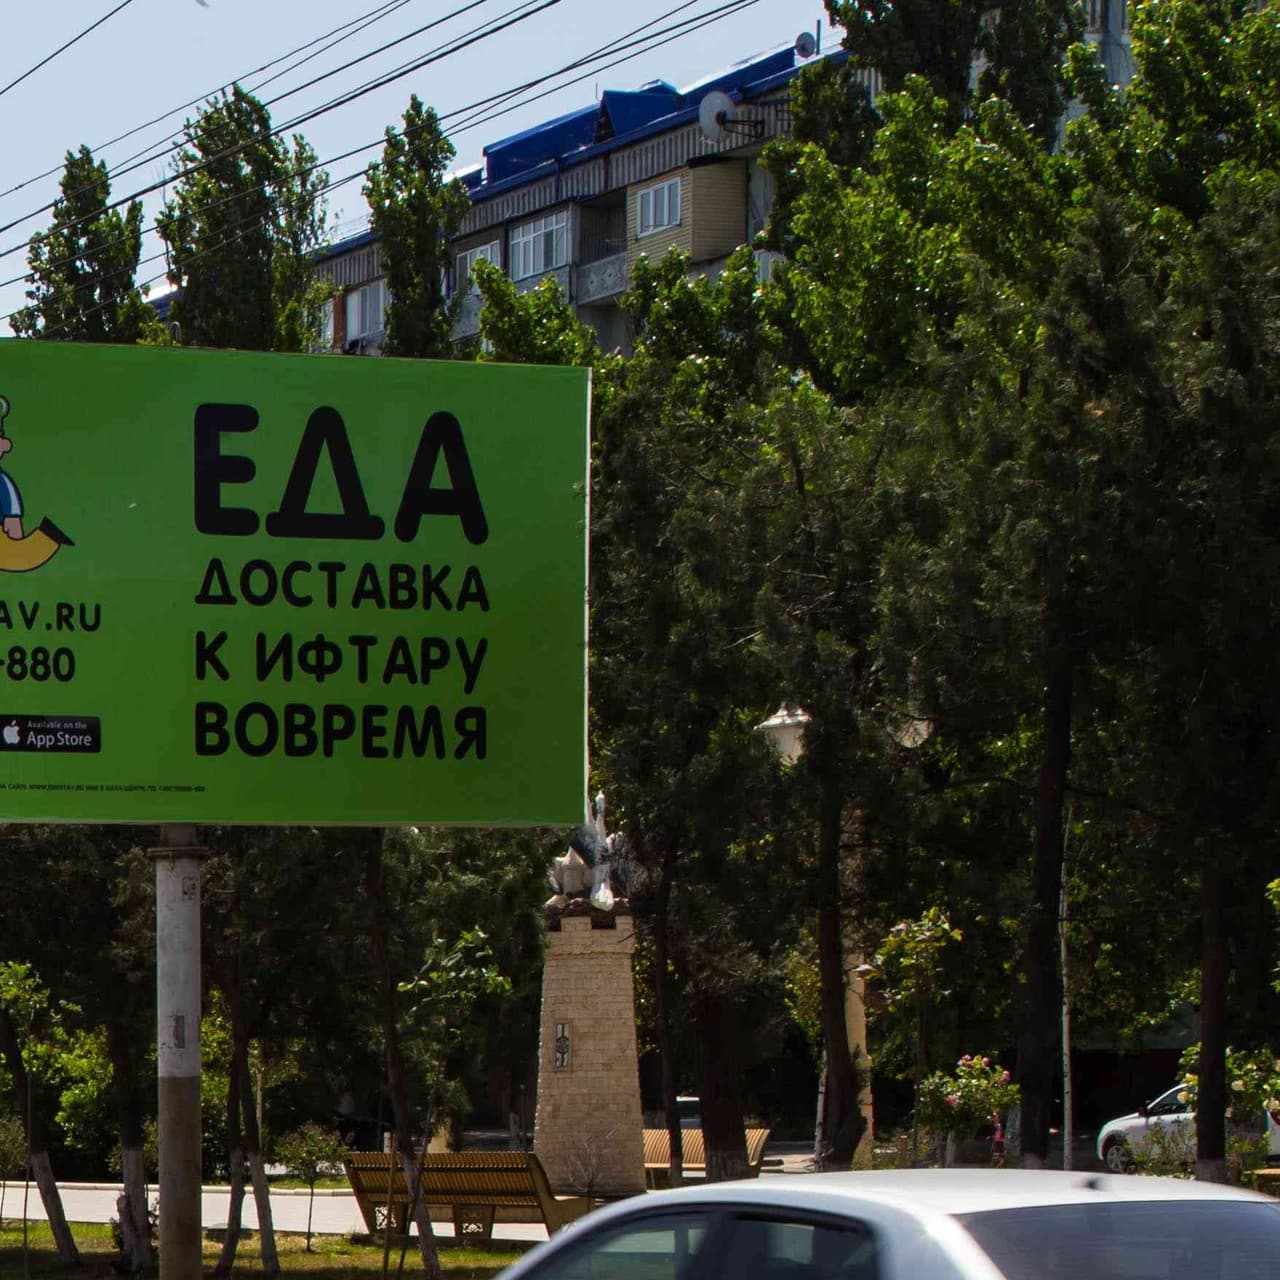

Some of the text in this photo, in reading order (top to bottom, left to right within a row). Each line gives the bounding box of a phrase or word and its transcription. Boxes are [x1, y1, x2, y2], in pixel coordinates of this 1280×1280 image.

[194, 402, 489, 545] ЕДА
[194, 558, 490, 612] ДОСТАВКА
[195, 631, 488, 695] К ИФТАРУ
[26, 731, 92, 749] App Store
[27, 720, 88, 729] Available on the
[194, 701, 488, 760] ВОВРЕМЯ
